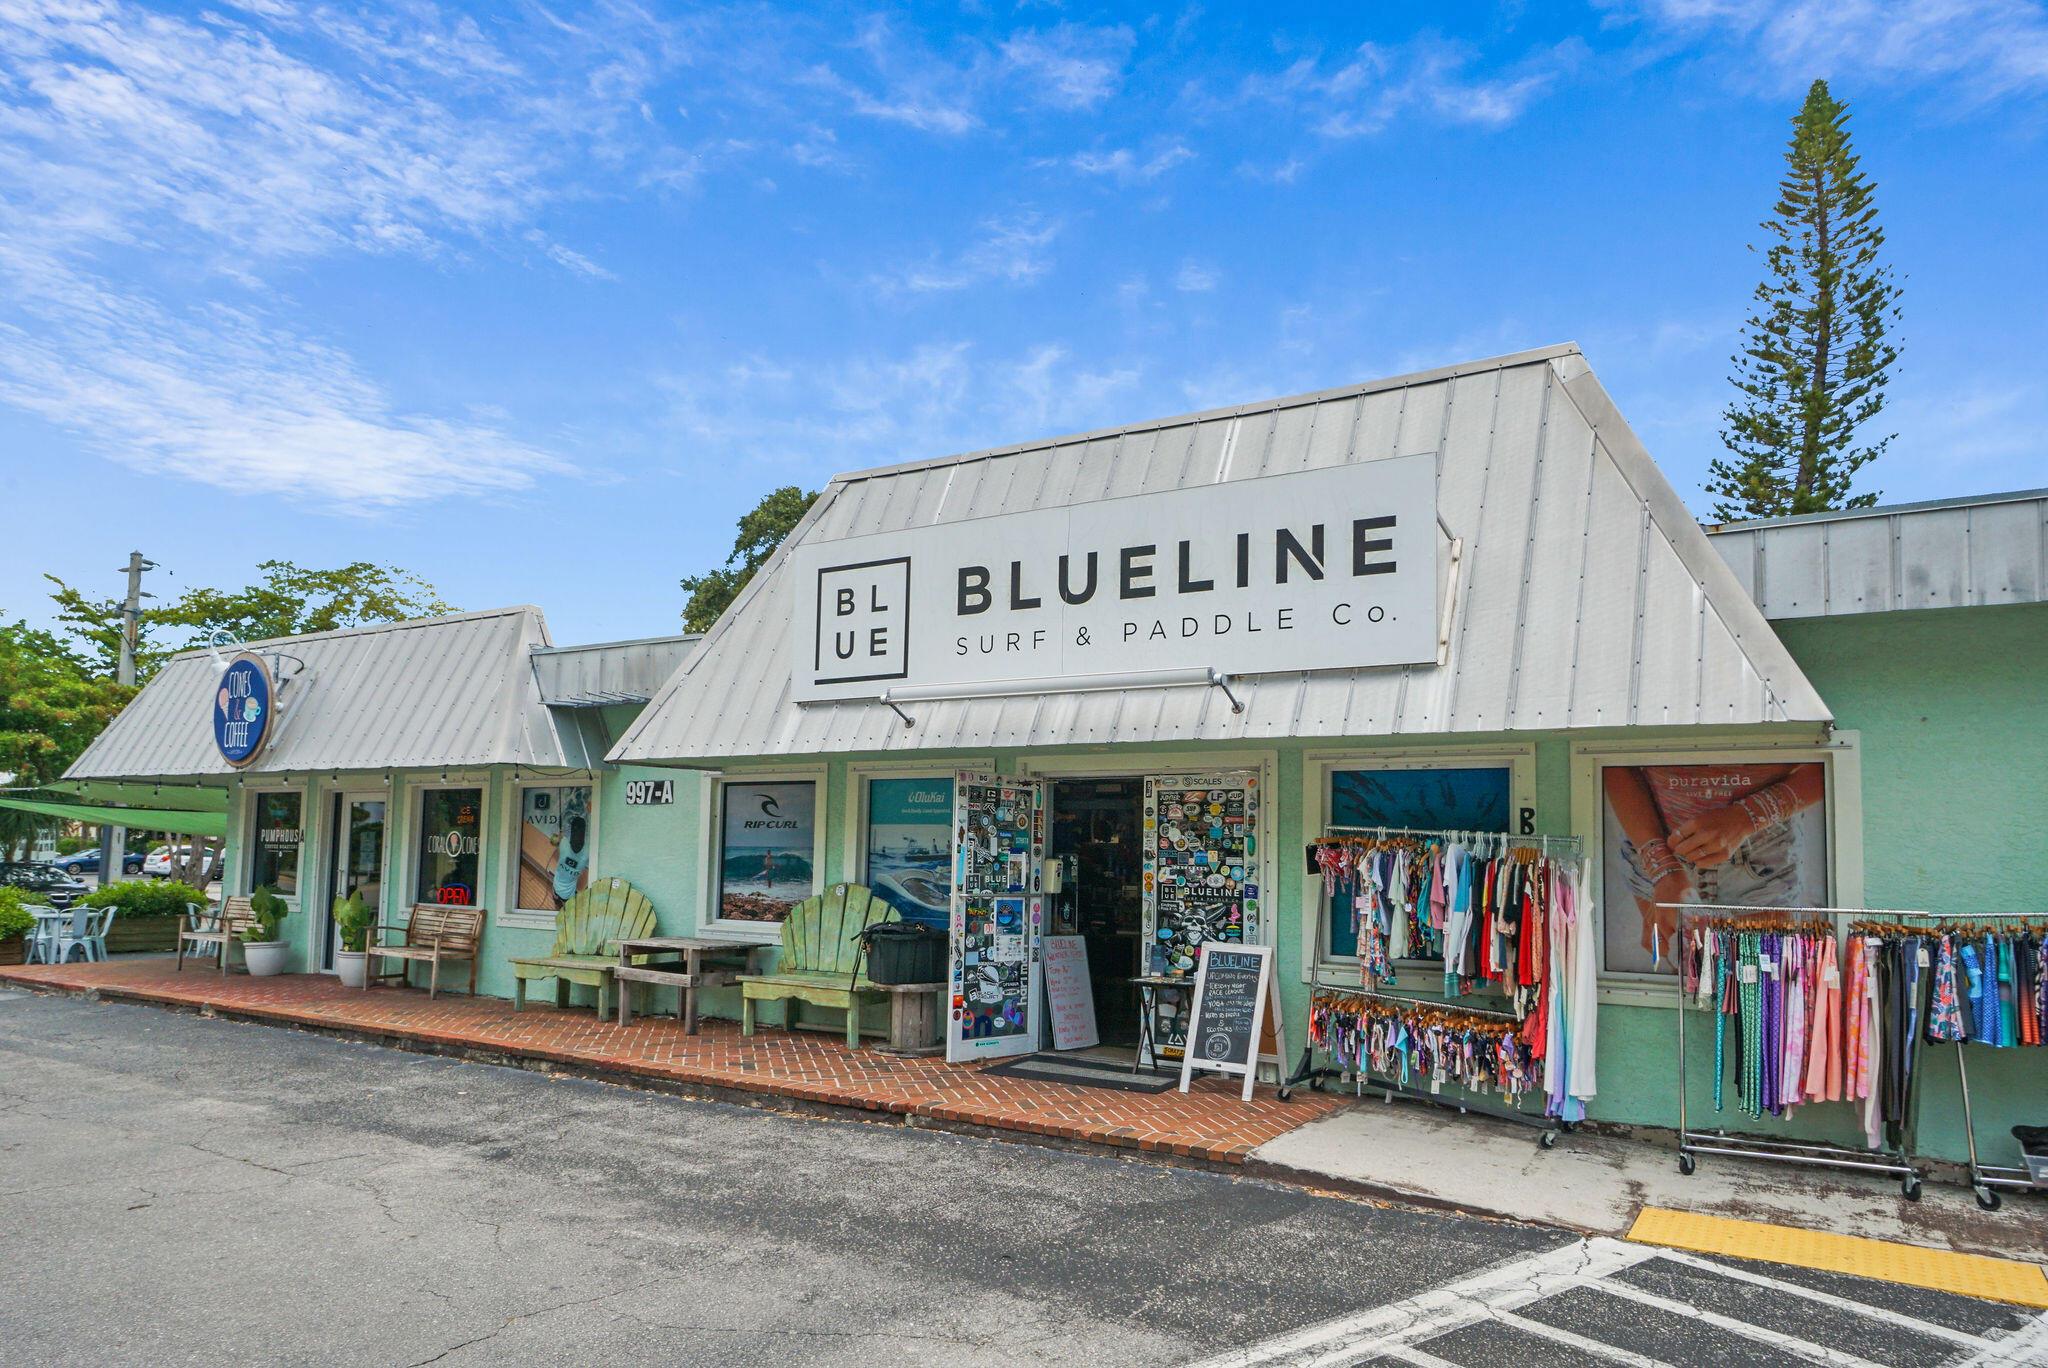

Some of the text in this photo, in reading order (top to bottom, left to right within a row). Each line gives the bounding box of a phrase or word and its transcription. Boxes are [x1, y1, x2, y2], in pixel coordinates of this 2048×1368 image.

[957, 514, 1397, 618] BLUELINE
[836, 584, 889, 617] BL
[957, 630, 1047, 657] SURF
[1077, 626, 1091, 646] &
[1123, 608, 1294, 644] PADDLE
[836, 627, 888, 661] UE
[229, 671, 252, 699] CONES
[224, 721, 249, 748] COFFEE
[1193, 777, 1222, 786] SCALES
[1668, 774, 1752, 789] puravida
[627, 781, 672, 804] 997-A
[914, 791, 946, 803] OluKai
[1211, 792, 1224, 801] LF
[526, 815, 558, 824] AVID
[744, 820, 799, 829] RIP CURL
[1519, 808, 1535, 835] B
[436, 888, 470, 905] OPEN
[1183, 887, 1240, 897] BLUELINE
[1210, 952, 1260, 968] BLUELINE
